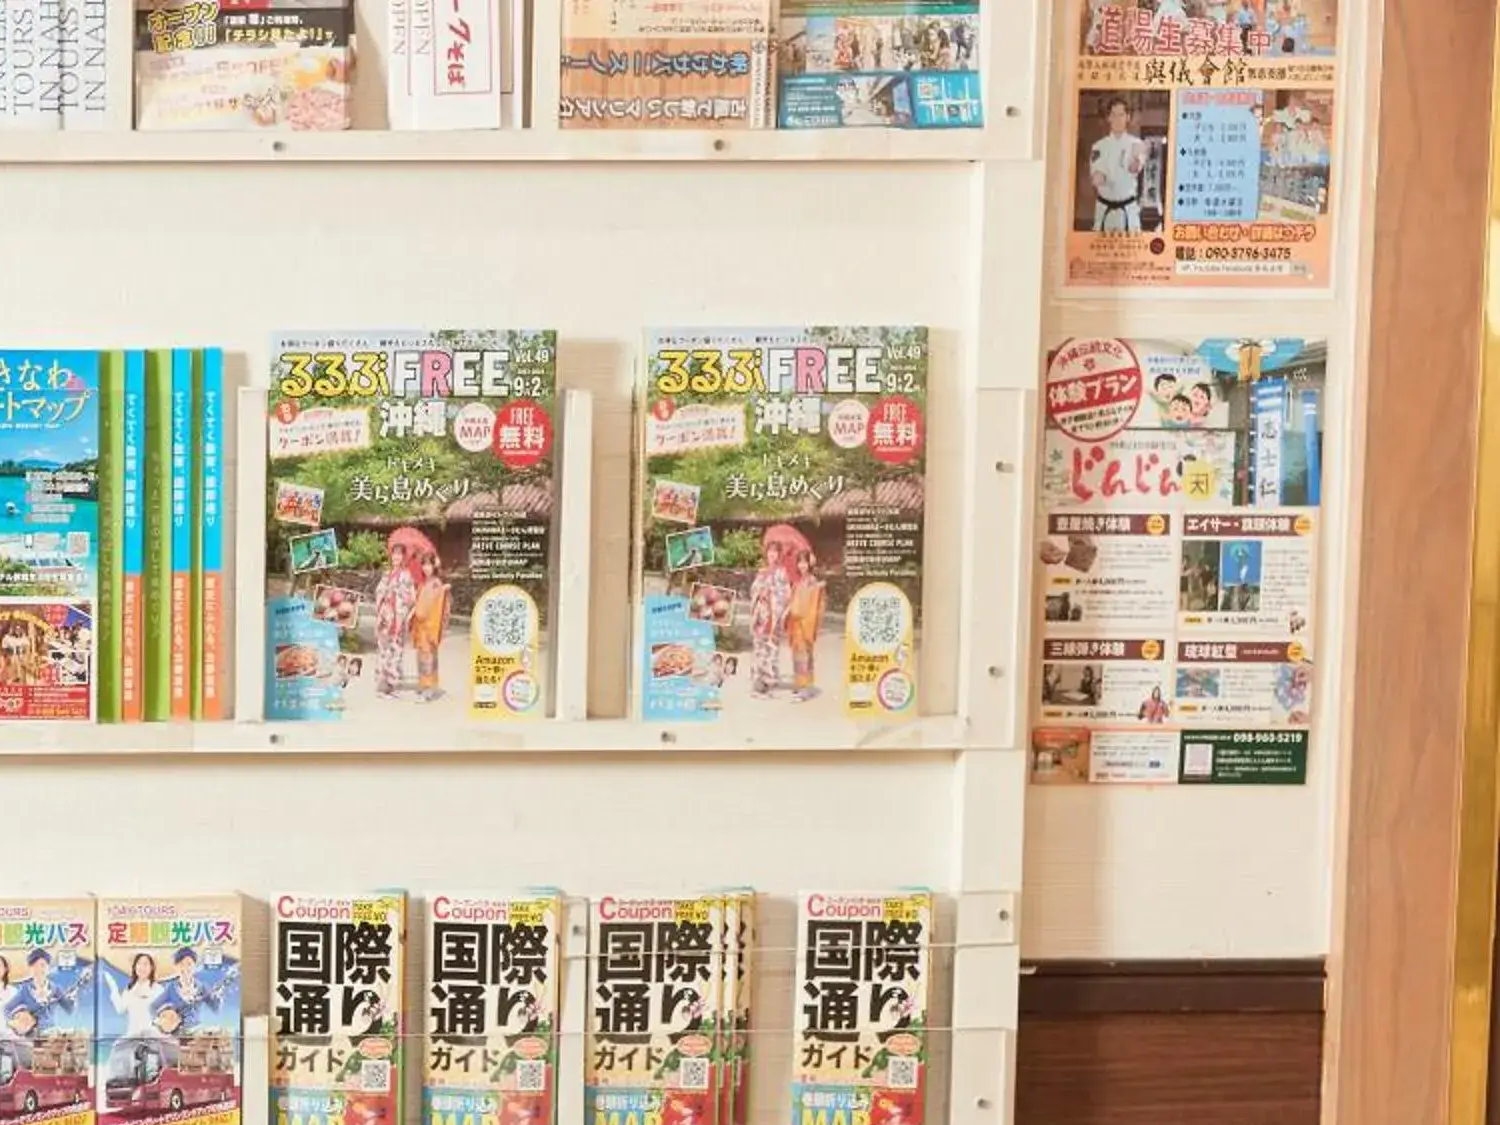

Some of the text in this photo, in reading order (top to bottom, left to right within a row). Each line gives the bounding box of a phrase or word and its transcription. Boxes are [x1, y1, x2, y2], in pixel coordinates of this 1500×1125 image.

[13, 8, 34, 115] TOURS
[279, 350, 511, 398] るるぶ FREE
[657, 347, 882, 395] るるぶ FREE
[380, 401, 447, 438] 沖縄
[755, 397, 821, 434] 沖縄
[499, 426, 545, 450] 無料
[873, 423, 918, 446] 無料
[352, 475, 470, 504] 美ら島めぐり
[726, 473, 844, 500] 美ら島めぐり
[277, 896, 350, 921] Coupon
[433, 896, 508, 921] Coupon
[599, 896, 674, 921] Coupon
[807, 894, 882, 918] Coupon
[107, 920, 234, 945] 定期観光バス
[277, 921, 393, 985] 国際
[432, 922, 549, 985] 国際
[599, 921, 714, 982] 国際
[805, 919, 924, 981] 国際
[276, 1047, 345, 1073] ガイド
[431, 1047, 500, 1073] ガイド
[594, 1045, 664, 1071] ガイド
[801, 1044, 873, 1070] ガイド
